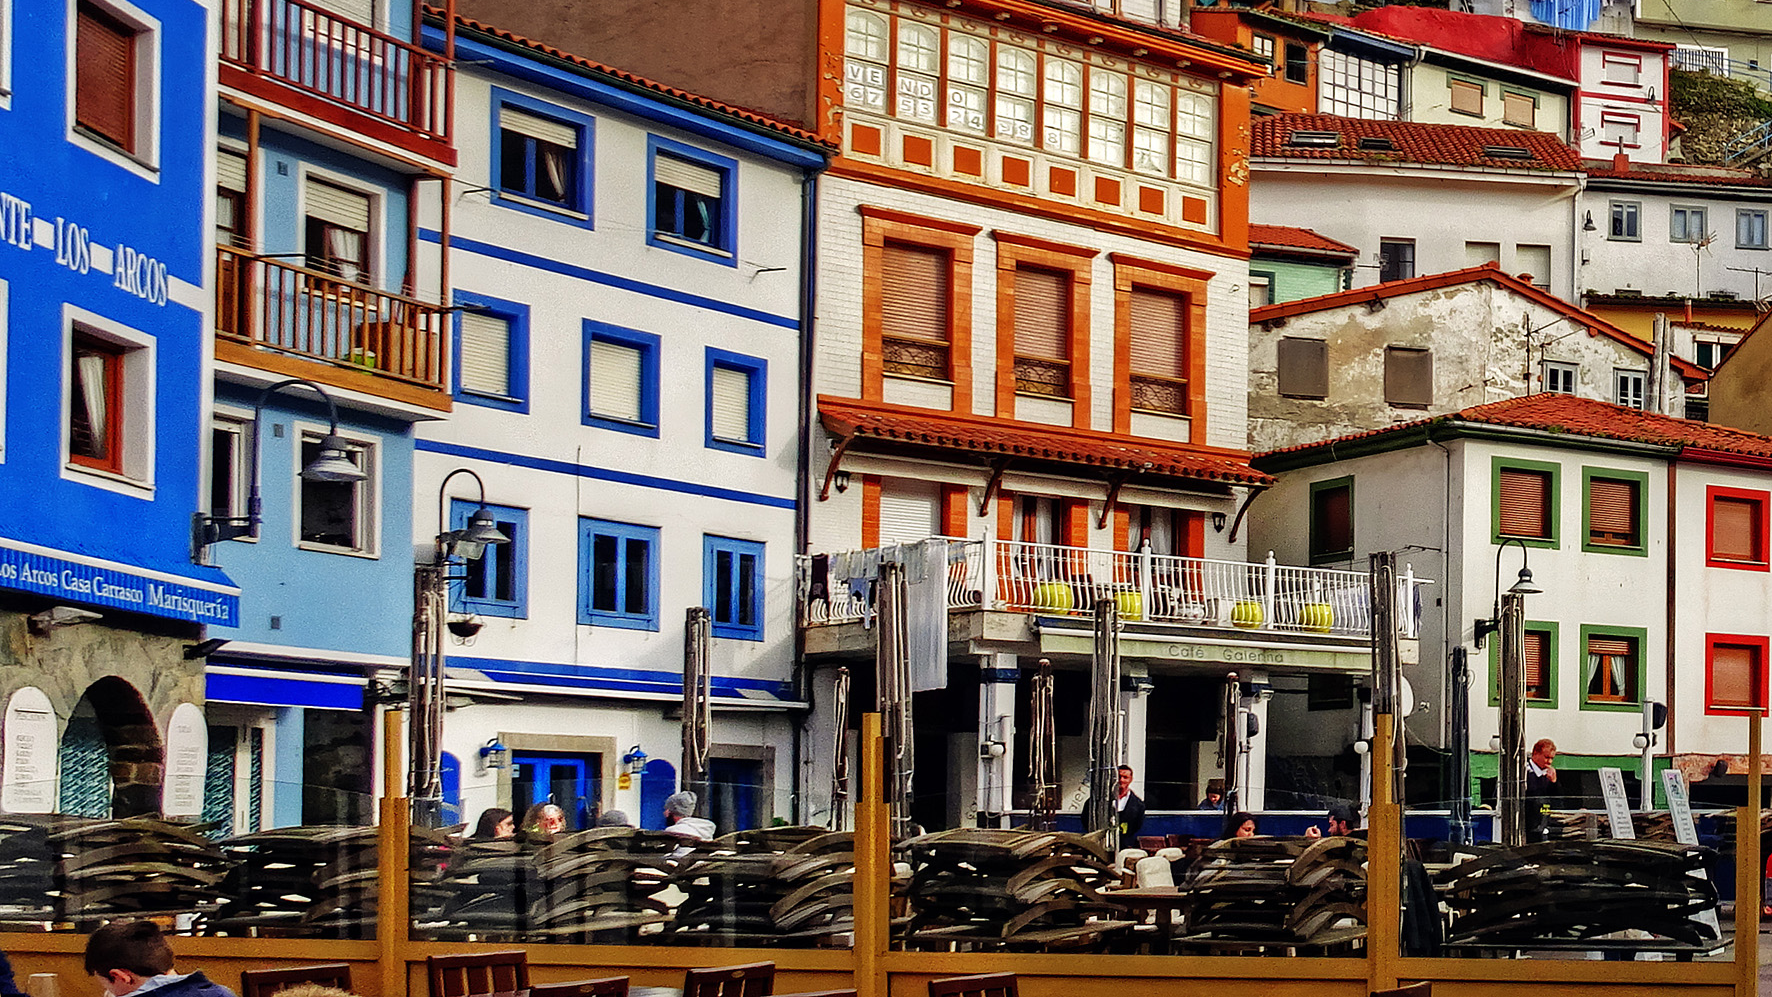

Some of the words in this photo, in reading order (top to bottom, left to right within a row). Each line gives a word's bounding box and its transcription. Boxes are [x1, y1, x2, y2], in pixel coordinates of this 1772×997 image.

[55, 216, 90, 275] LOS
[114, 243, 167, 307] ARCOS
[0, 562, 17, 580] os
[20, 562, 58, 587] Arcos
[61, 570, 91, 594] Casa
[93, 577, 144, 603] Carrasco
[149, 584, 229, 621] Marisquería
[1168, 645, 1205, 659] Café
